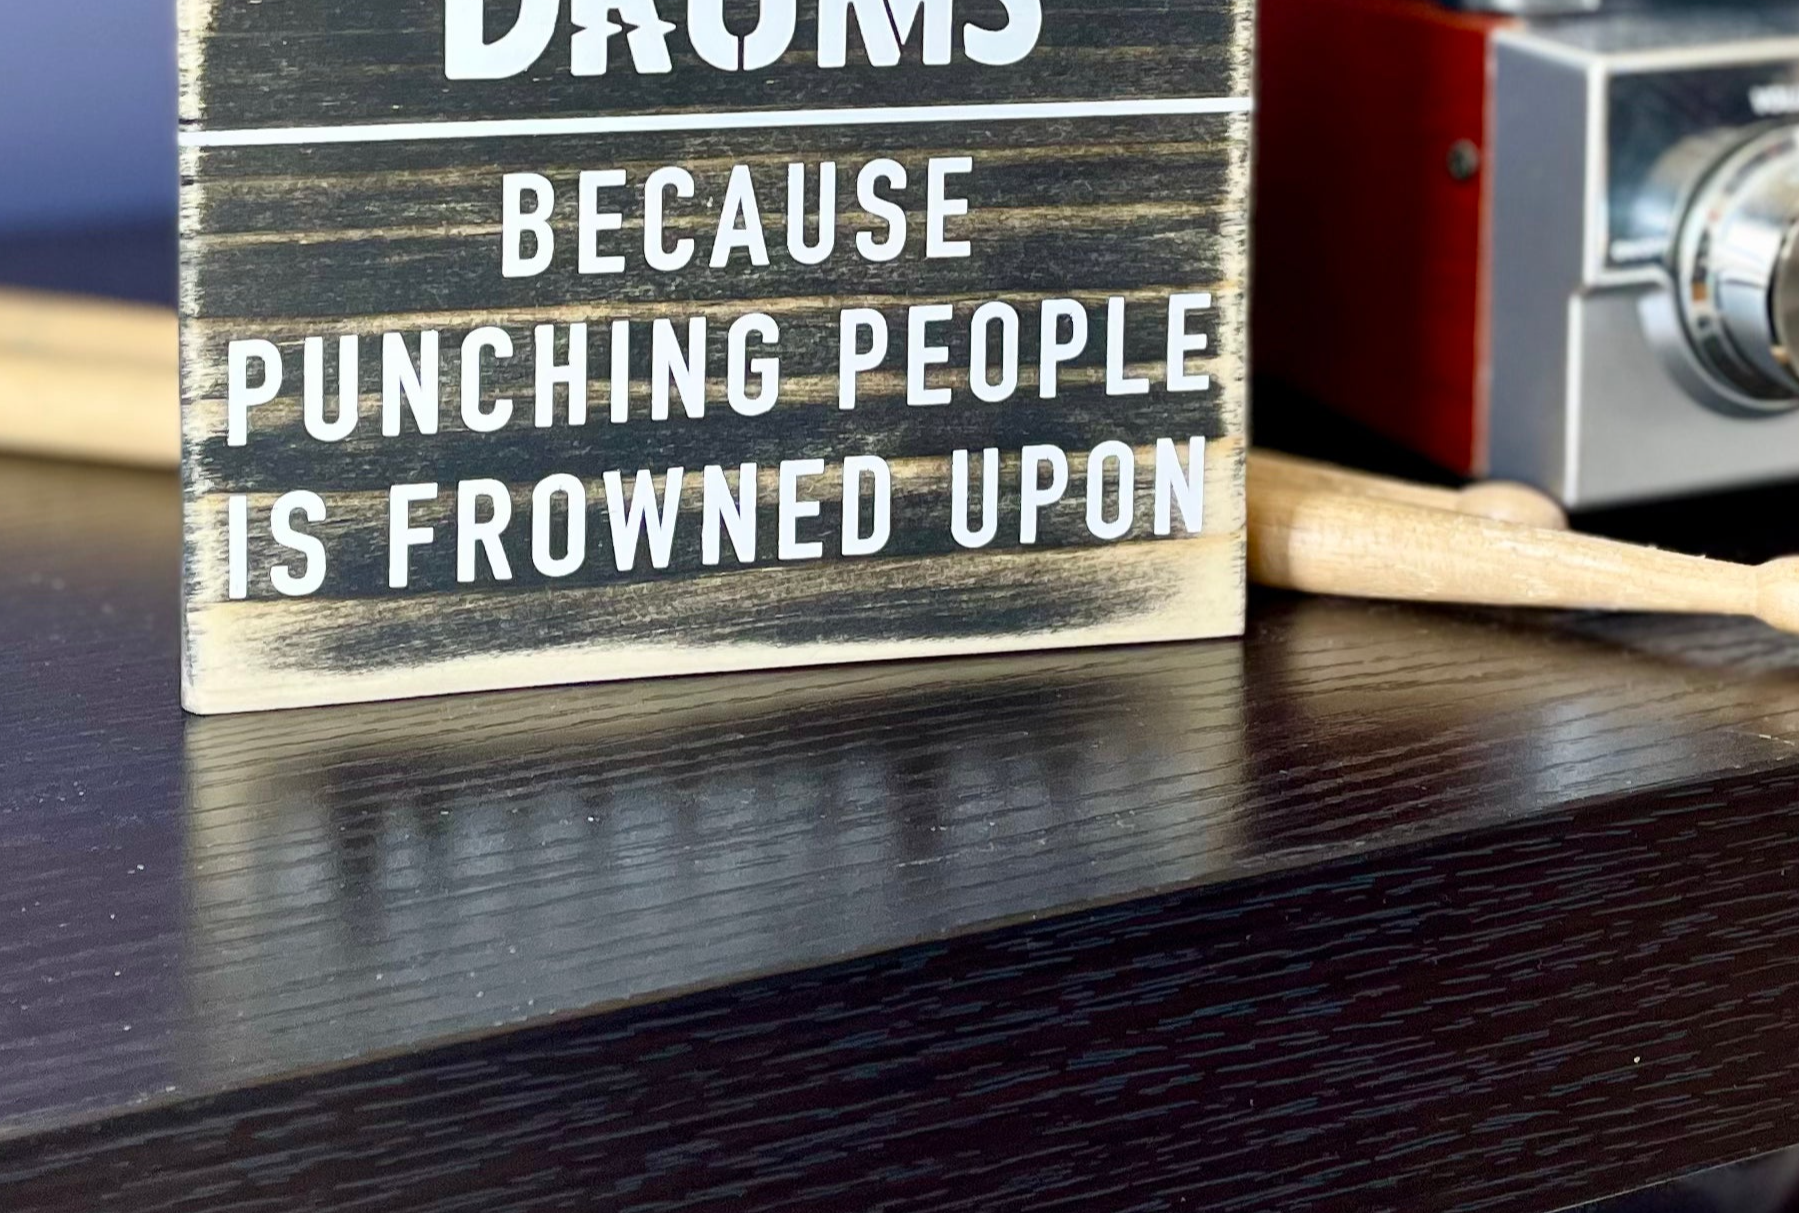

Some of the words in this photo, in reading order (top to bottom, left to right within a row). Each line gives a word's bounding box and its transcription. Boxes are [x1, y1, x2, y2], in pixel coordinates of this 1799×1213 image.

[501, 156, 973, 278] BECAUSE
[226, 312, 781, 446] PUNCHING
[837, 292, 1212, 410] PEOPLE
[227, 490, 327, 601] IS
[388, 455, 892, 589] FROWNED
[950, 435, 1207, 549] UPON
